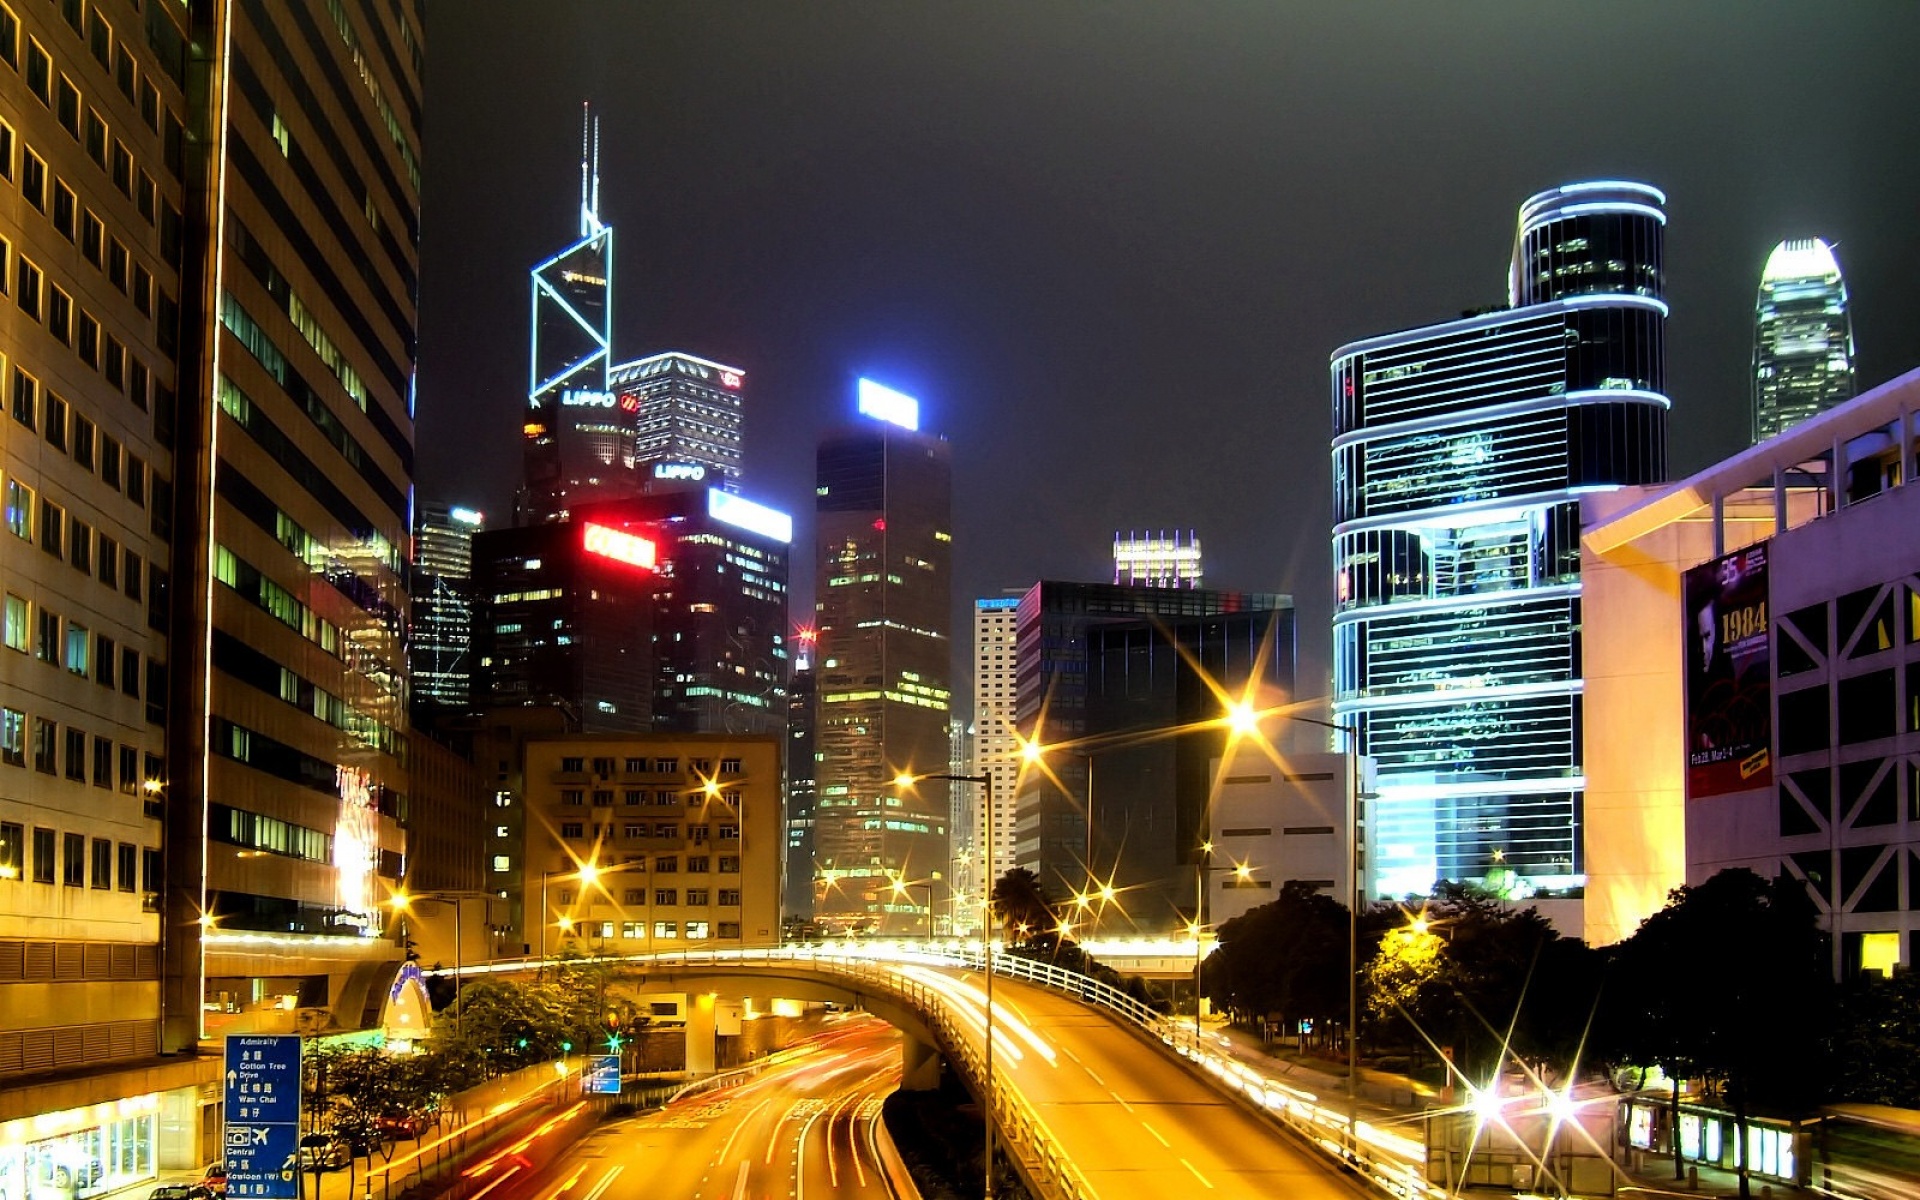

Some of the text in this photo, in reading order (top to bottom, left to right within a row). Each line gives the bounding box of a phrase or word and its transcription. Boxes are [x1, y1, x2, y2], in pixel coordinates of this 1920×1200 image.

[563, 390, 616, 408] LIPPO
[655, 464, 704, 480] LIPPO
[1722, 602, 1767, 644] 1984
[240, 1038, 277, 1046] Admiralty
